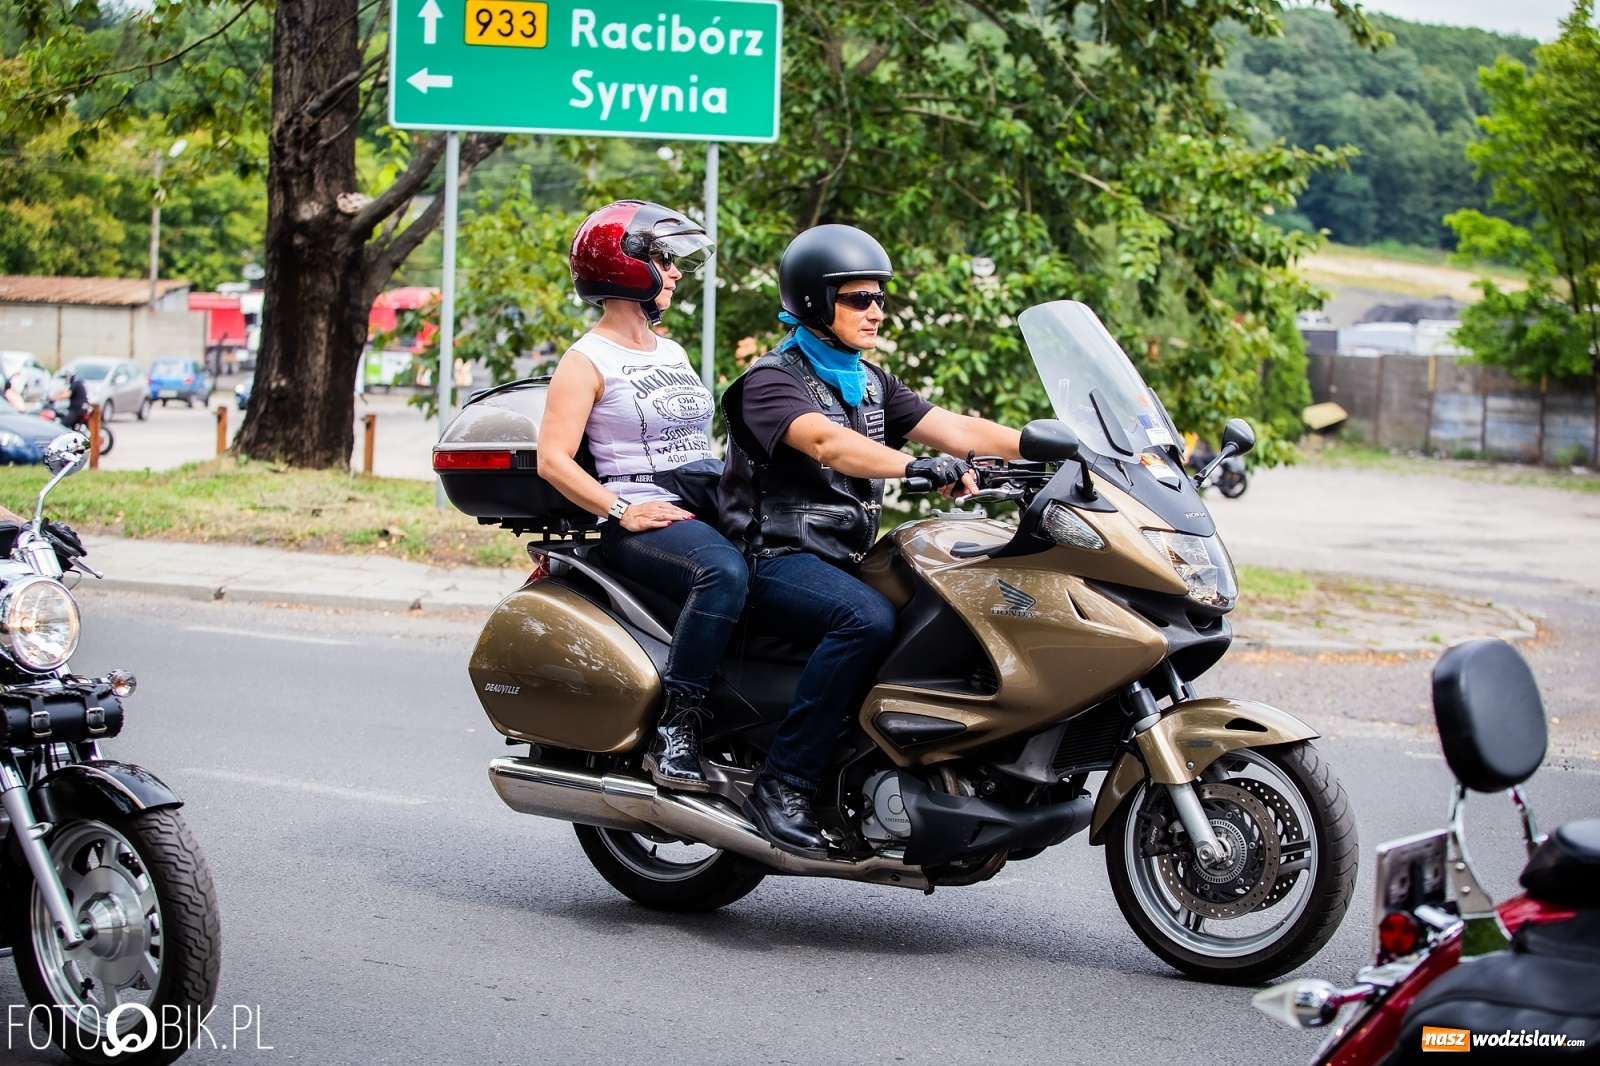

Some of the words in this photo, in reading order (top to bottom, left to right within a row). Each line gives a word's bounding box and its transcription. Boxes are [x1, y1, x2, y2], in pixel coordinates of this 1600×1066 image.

[475, 9, 538, 38] 933
[571, 9, 763, 56] Racibórz
[569, 69, 728, 122] Syrynia
[629, 374, 666, 399] JACK
[678, 396, 695, 404] Old
[667, 453, 688, 464] 40cl
[991, 608, 1035, 618] HONDA
[485, 683, 520, 694] DEAUVILLE
